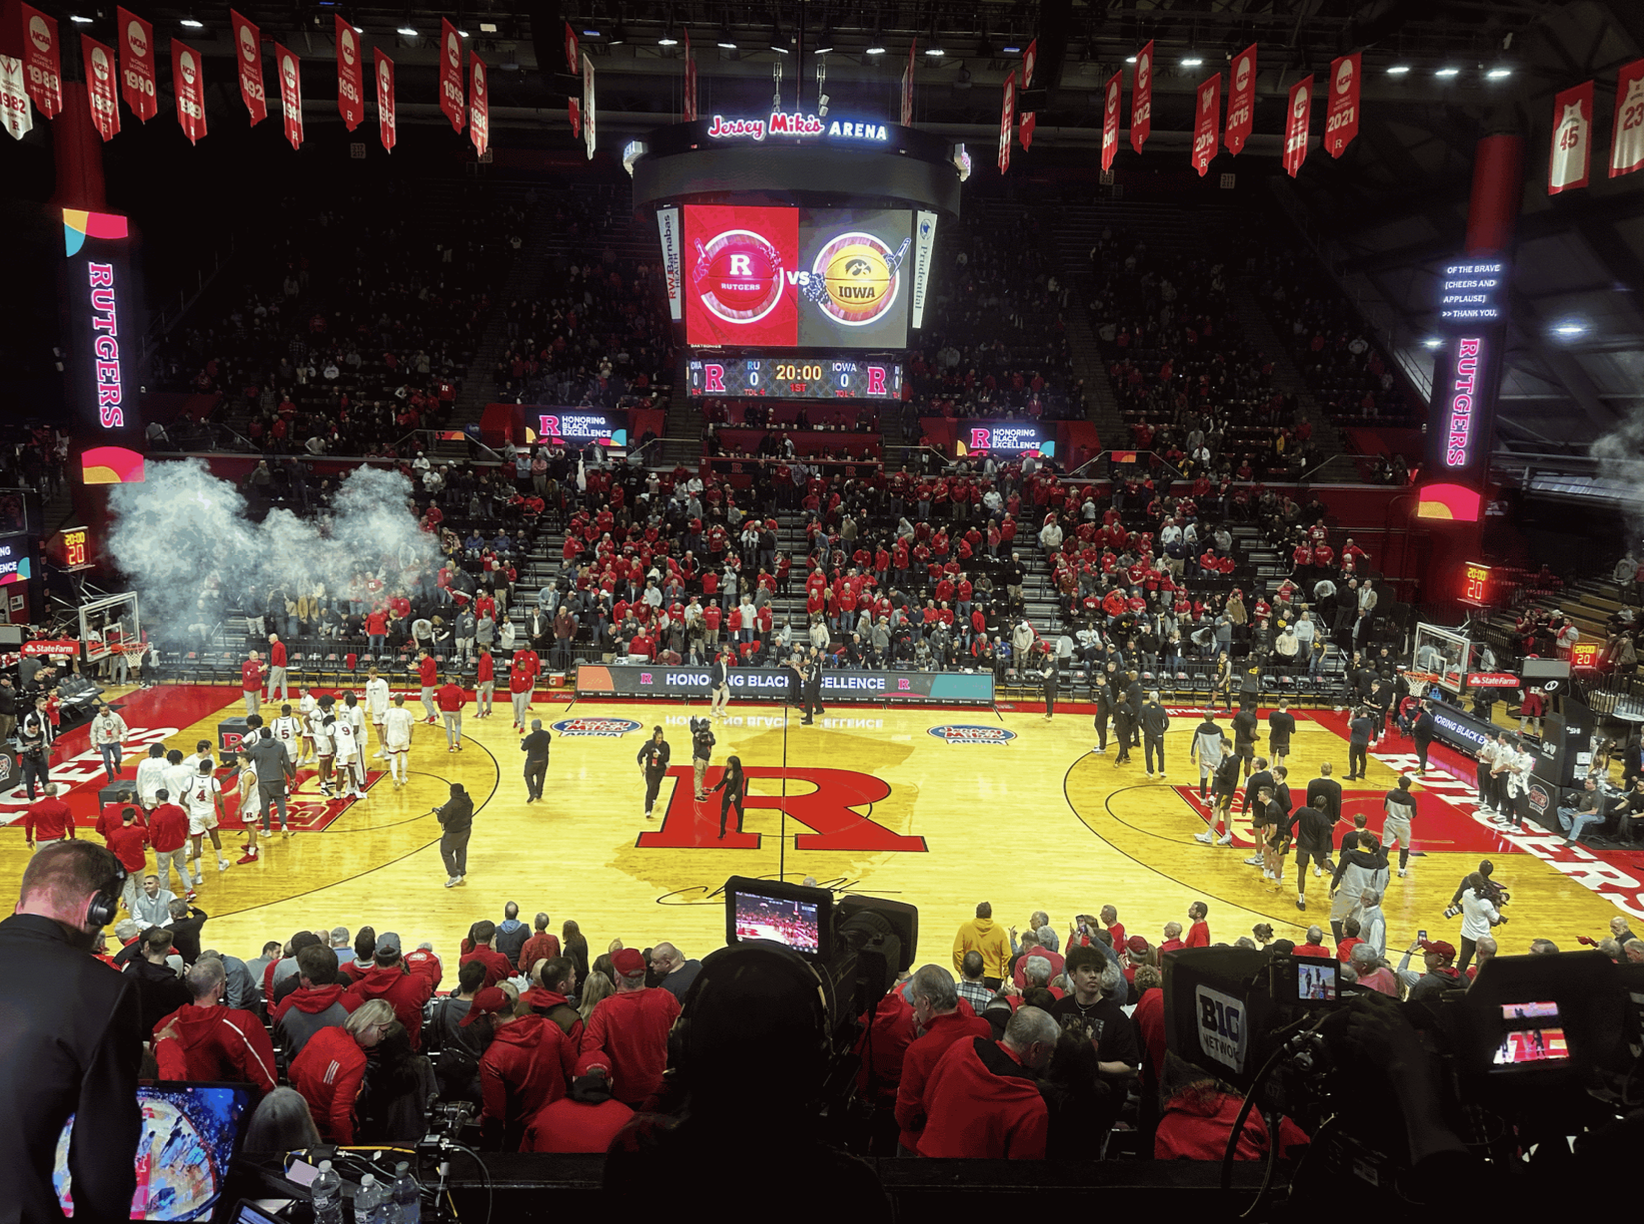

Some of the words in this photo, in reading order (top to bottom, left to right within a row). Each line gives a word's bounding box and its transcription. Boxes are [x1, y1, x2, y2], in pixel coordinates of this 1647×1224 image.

[346, 109, 354, 122] R
[1327, 105, 1356, 133] 2021
[1623, 101, 1645, 132] 23
[708, 115, 766, 141] Jersey
[768, 112, 825, 135] Mike's
[828, 121, 888, 140] ARENA
[1335, 137, 1344, 149] R
[1560, 124, 1580, 152] 45
[1199, 157, 1208, 168] R
[673, 253, 681, 288] HEALTH
[729, 254, 752, 276] R
[1447, 266, 1458, 274] OF
[1458, 265, 1474, 274] THE
[1474, 264, 1501, 273] BRAVE
[914, 246, 929, 309] Prudential
[721, 282, 760, 291] RUTGERS
[1445, 280, 1478, 290] [CHEERS
[1478, 279, 1497, 288] AND
[839, 285, 875, 299] IOWA
[1443, 294, 1486, 303] APPLAUSE]
[1453, 309, 1478, 317] THANK
[88, 261, 124, 430] RUTGERS
[747, 361, 760, 374] RU
[775, 364, 822, 381] 20:00
[832, 362, 857, 375] IOWA
[704, 363, 726, 393] R
[749, 371, 759, 387] 0
[840, 373, 849, 388] 0
[867, 366, 887, 395] R
[790, 382, 807, 393] 1ST
[1446, 337, 1480, 467] RUTGERS
[539, 414, 561, 436] R
[562, 415, 606, 425] HONORING
[562, 422, 589, 431] BLACK
[562, 428, 612, 438] EXCELLENCE
[970, 428, 991, 449] R
[992, 435, 1018, 443] BLACK
[993, 428, 1036, 437] HONORING
[992, 441, 1041, 449] EXCELLENCE
[846, 465, 857, 477] R
[64, 531, 86, 546] 20:00
[68, 544, 85, 565] 20
[1466, 567, 1487, 581] 20:00
[1467, 579, 1483, 600] 20
[1576, 654, 1591, 665] 20
[549, 677, 556, 685] G
[640, 673, 654, 685] R
[666, 673, 745, 688] HONONG
[898, 678, 911, 691] R
[281, 729, 289, 740] 5
[342, 725, 350, 736] 9
[195, 789, 207, 802] 4
[634, 764, 928, 853] R
